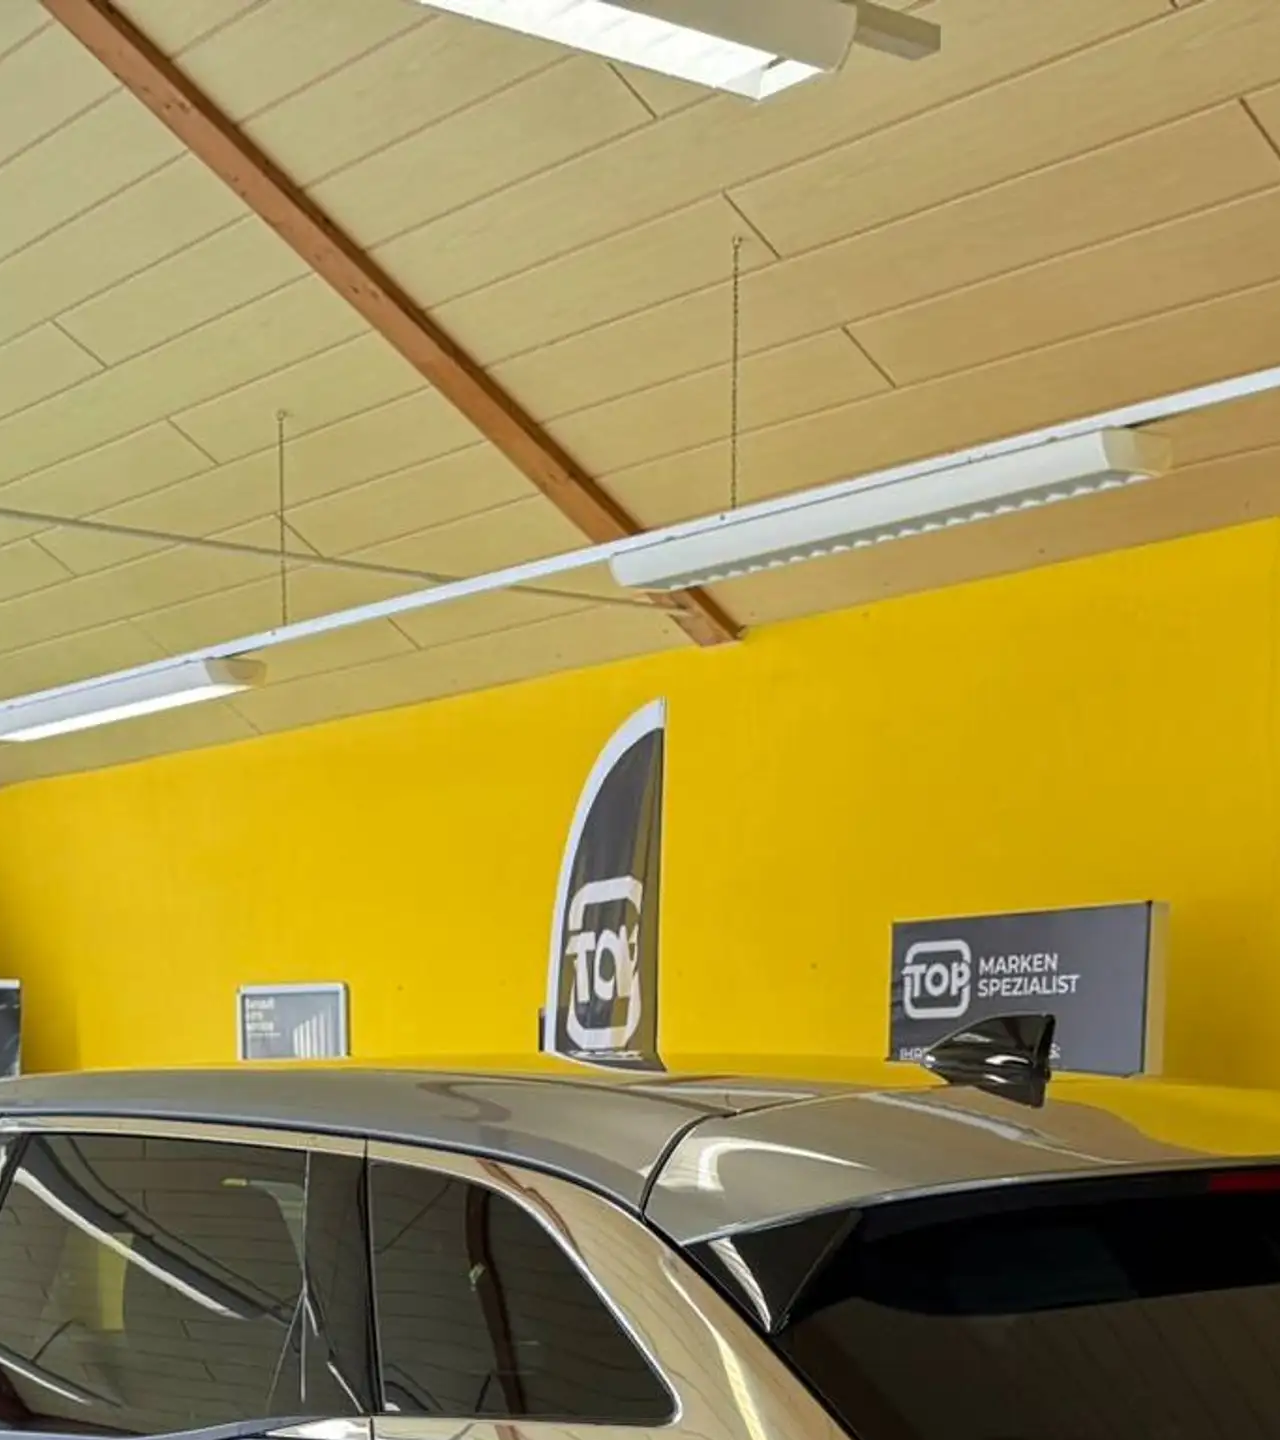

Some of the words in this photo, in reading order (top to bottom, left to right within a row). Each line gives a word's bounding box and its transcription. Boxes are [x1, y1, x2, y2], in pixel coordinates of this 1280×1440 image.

[978, 952, 1059, 976] MARKEN
[902, 961, 970, 998] TOP
[977, 973, 1081, 998] SPEZIALIST
